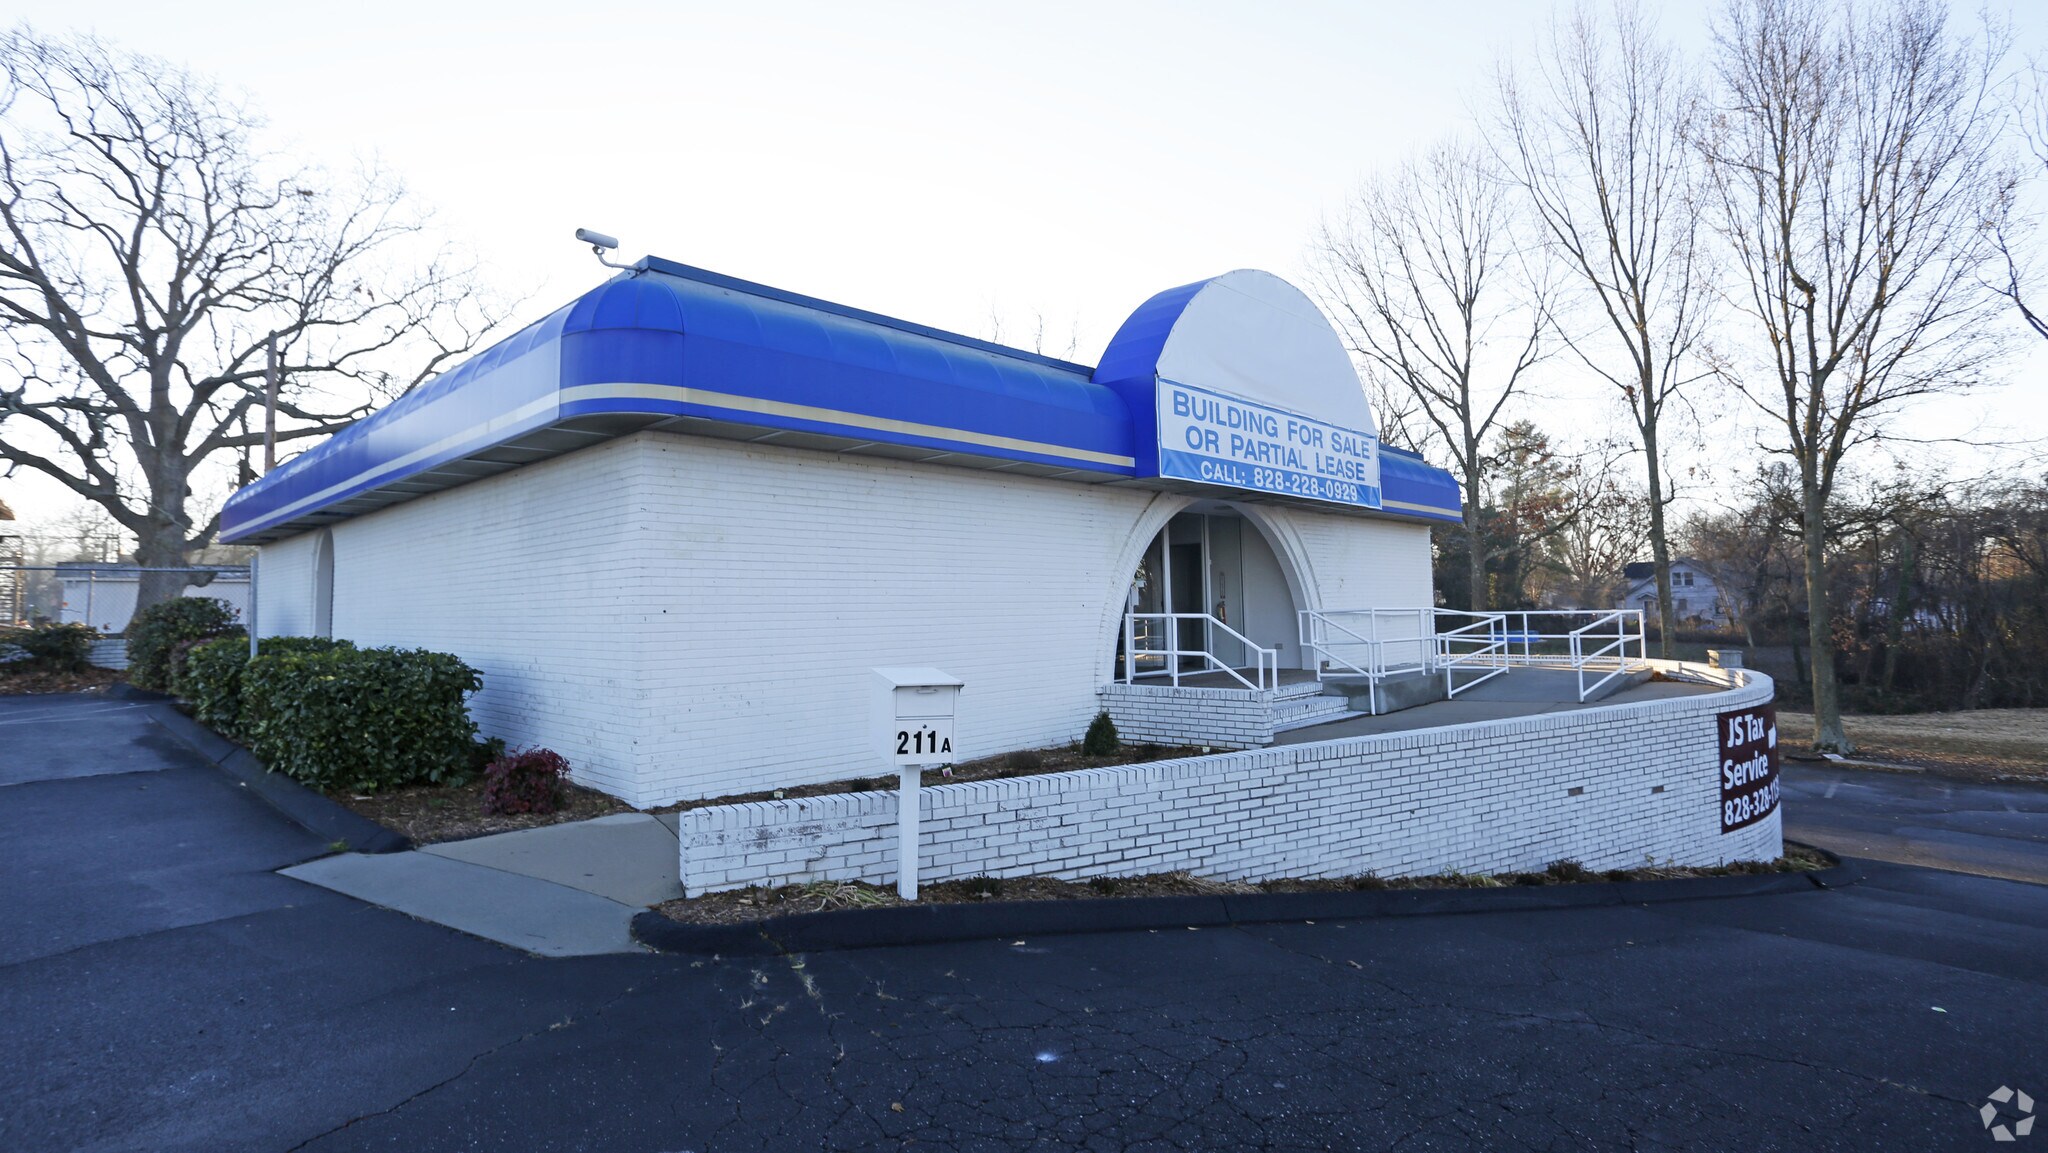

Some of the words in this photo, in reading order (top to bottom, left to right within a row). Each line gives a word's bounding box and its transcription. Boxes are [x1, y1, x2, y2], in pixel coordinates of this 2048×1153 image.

[1173, 390, 1278, 438] BUILDING
[1287, 420, 1323, 448] FOR
[1331, 432, 1370, 459] SALE
[1185, 426, 1219, 454] OR
[1231, 433, 1308, 470] PARTIAL
[1316, 452, 1366, 481] LEASE
[1200, 460, 1246, 484] CALL:
[1254, 467, 1358, 501] 828-228-0929
[1727, 715, 1744, 748] JS
[1744, 713, 1765, 742] Tax
[1723, 750, 1768, 790] Service
